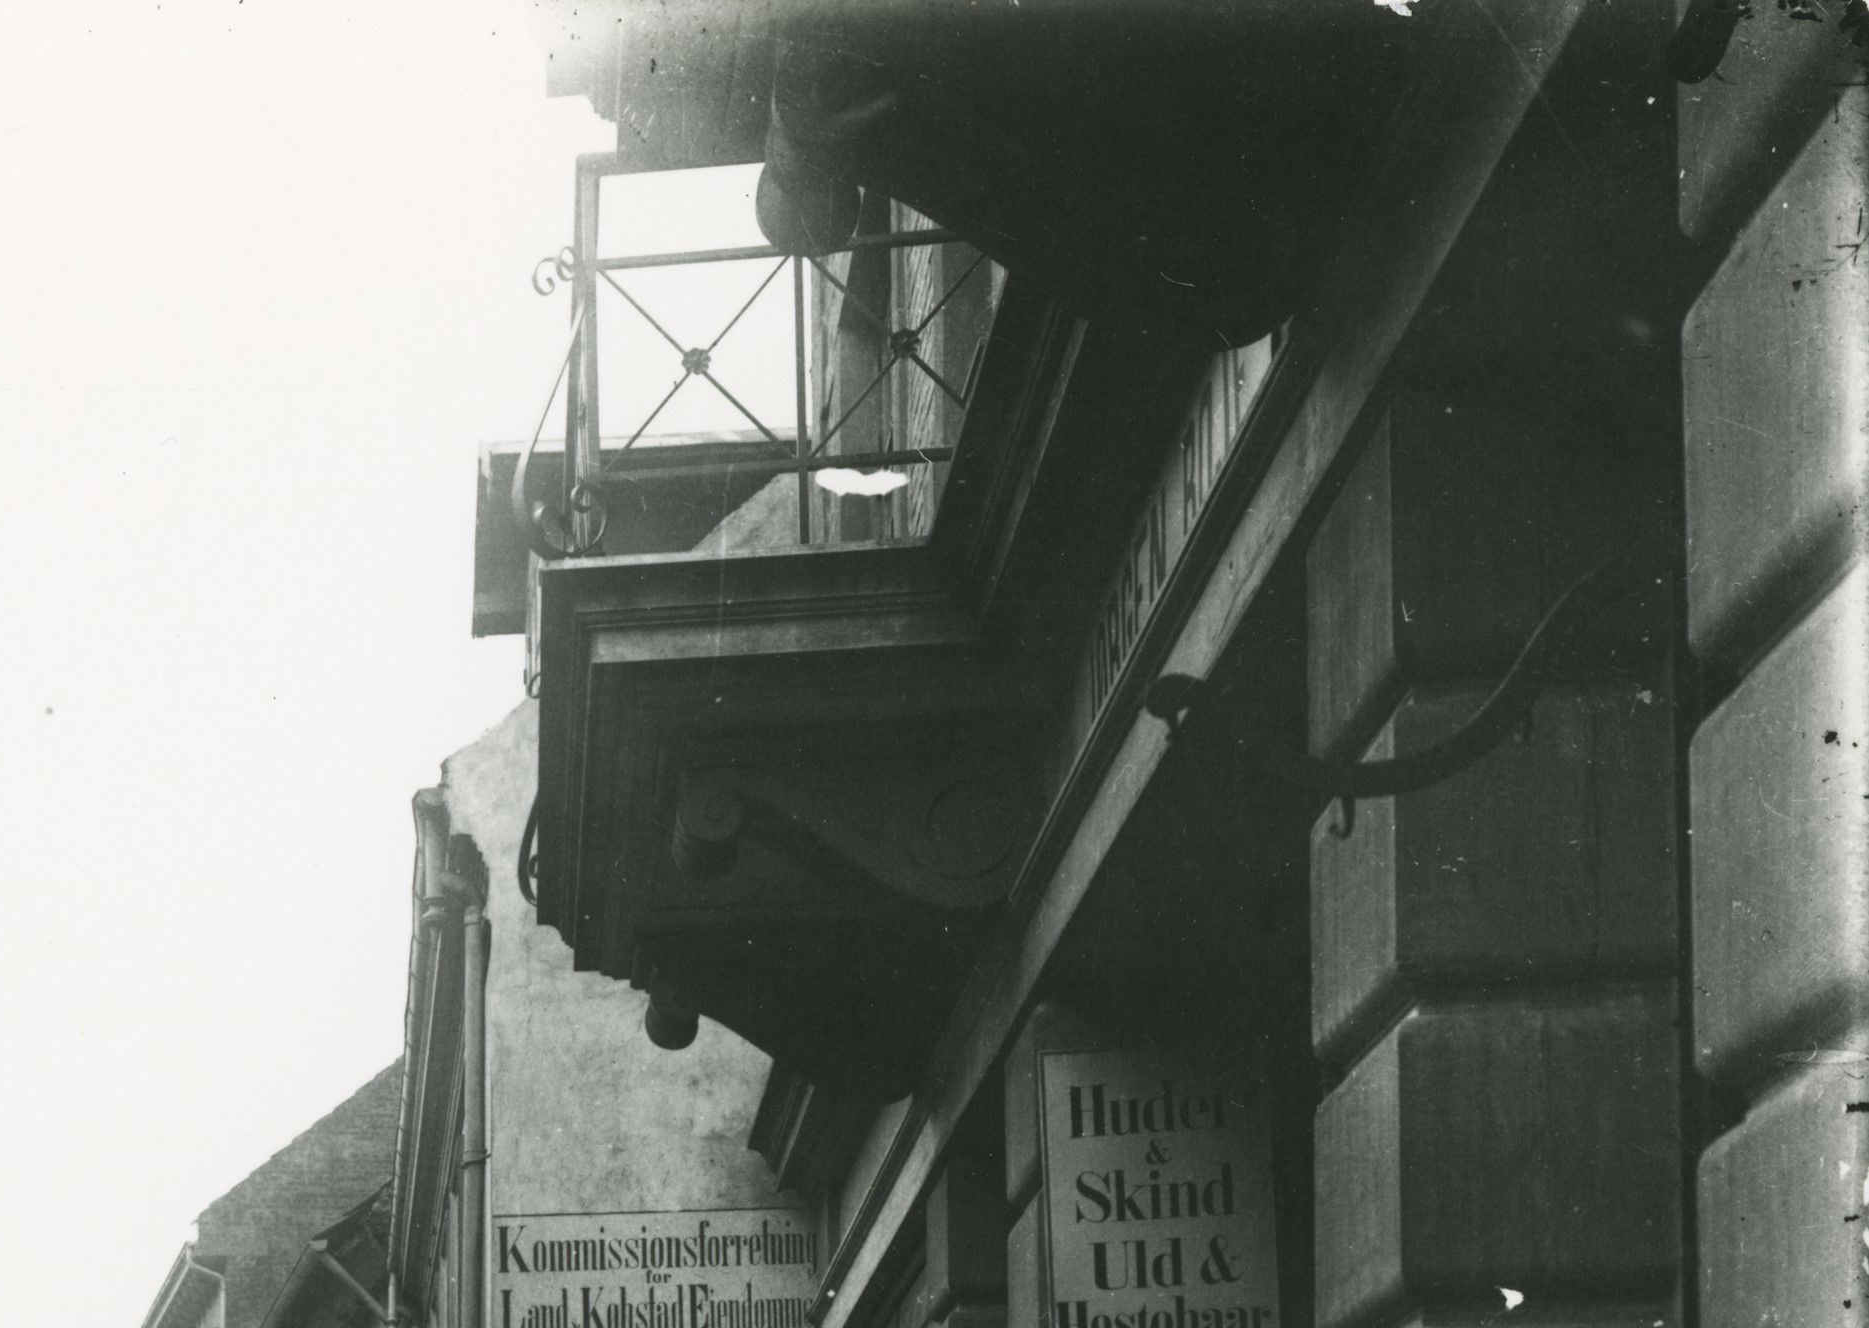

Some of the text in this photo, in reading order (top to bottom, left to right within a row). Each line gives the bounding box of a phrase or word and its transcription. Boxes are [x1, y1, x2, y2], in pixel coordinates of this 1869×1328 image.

[1144, 1139, 1172, 1165] &
[1075, 1162, 1237, 1225] Skind
[498, 1218, 818, 1280] Kommissionsforretning
[645, 1269, 672, 1284] for
[1088, 1234, 1243, 1291] Uld &
